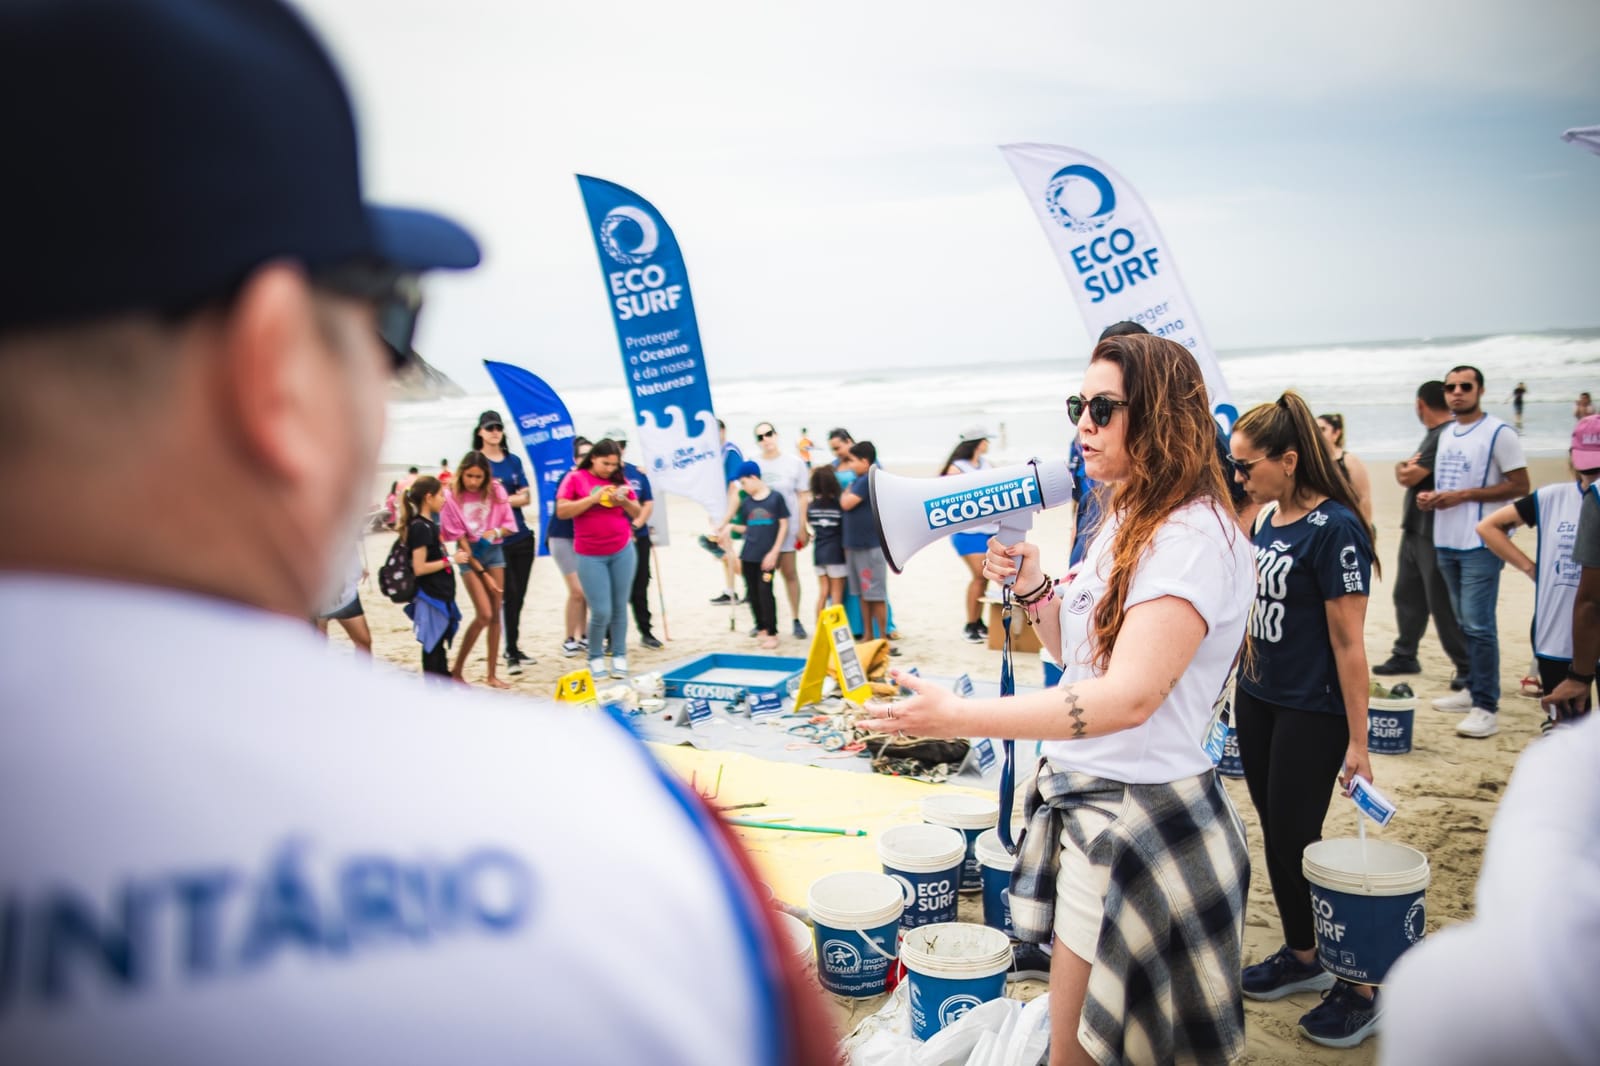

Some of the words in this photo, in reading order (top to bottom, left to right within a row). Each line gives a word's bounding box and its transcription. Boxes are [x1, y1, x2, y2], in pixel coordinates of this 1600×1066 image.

[1070, 228, 1135, 274] ECO
[610, 264, 665, 296] ECO
[1084, 248, 1159, 303] SURF
[616, 284, 682, 320] SURF
[1155, 319, 1184, 337] ano
[625, 329, 680, 349] Proteger
[630, 355, 638, 365] o
[639, 344, 689, 363] Oceano
[642, 366, 659, 380] da
[661, 358, 695, 375] nossa
[636, 374, 695, 397] Natureza
[929, 477, 1035, 527] ecosurf
[941, 493, 972, 506] PROTEJO
[973, 490, 984, 498] OS
[985, 481, 1019, 495] OCEANOS
[1343, 571, 1361, 583] ECO
[1345, 581, 1363, 593] SUR
[1372, 716, 1399, 728] ECO
[1372, 727, 1404, 738] SURF
[1225, 735, 1239, 746] EC
[1223, 746, 1240, 758] SU
[917, 880, 950, 897] ECO
[918, 890, 955, 911] SURF
[1311, 893, 1333, 919] CO
[1313, 912, 1346, 942] URF
